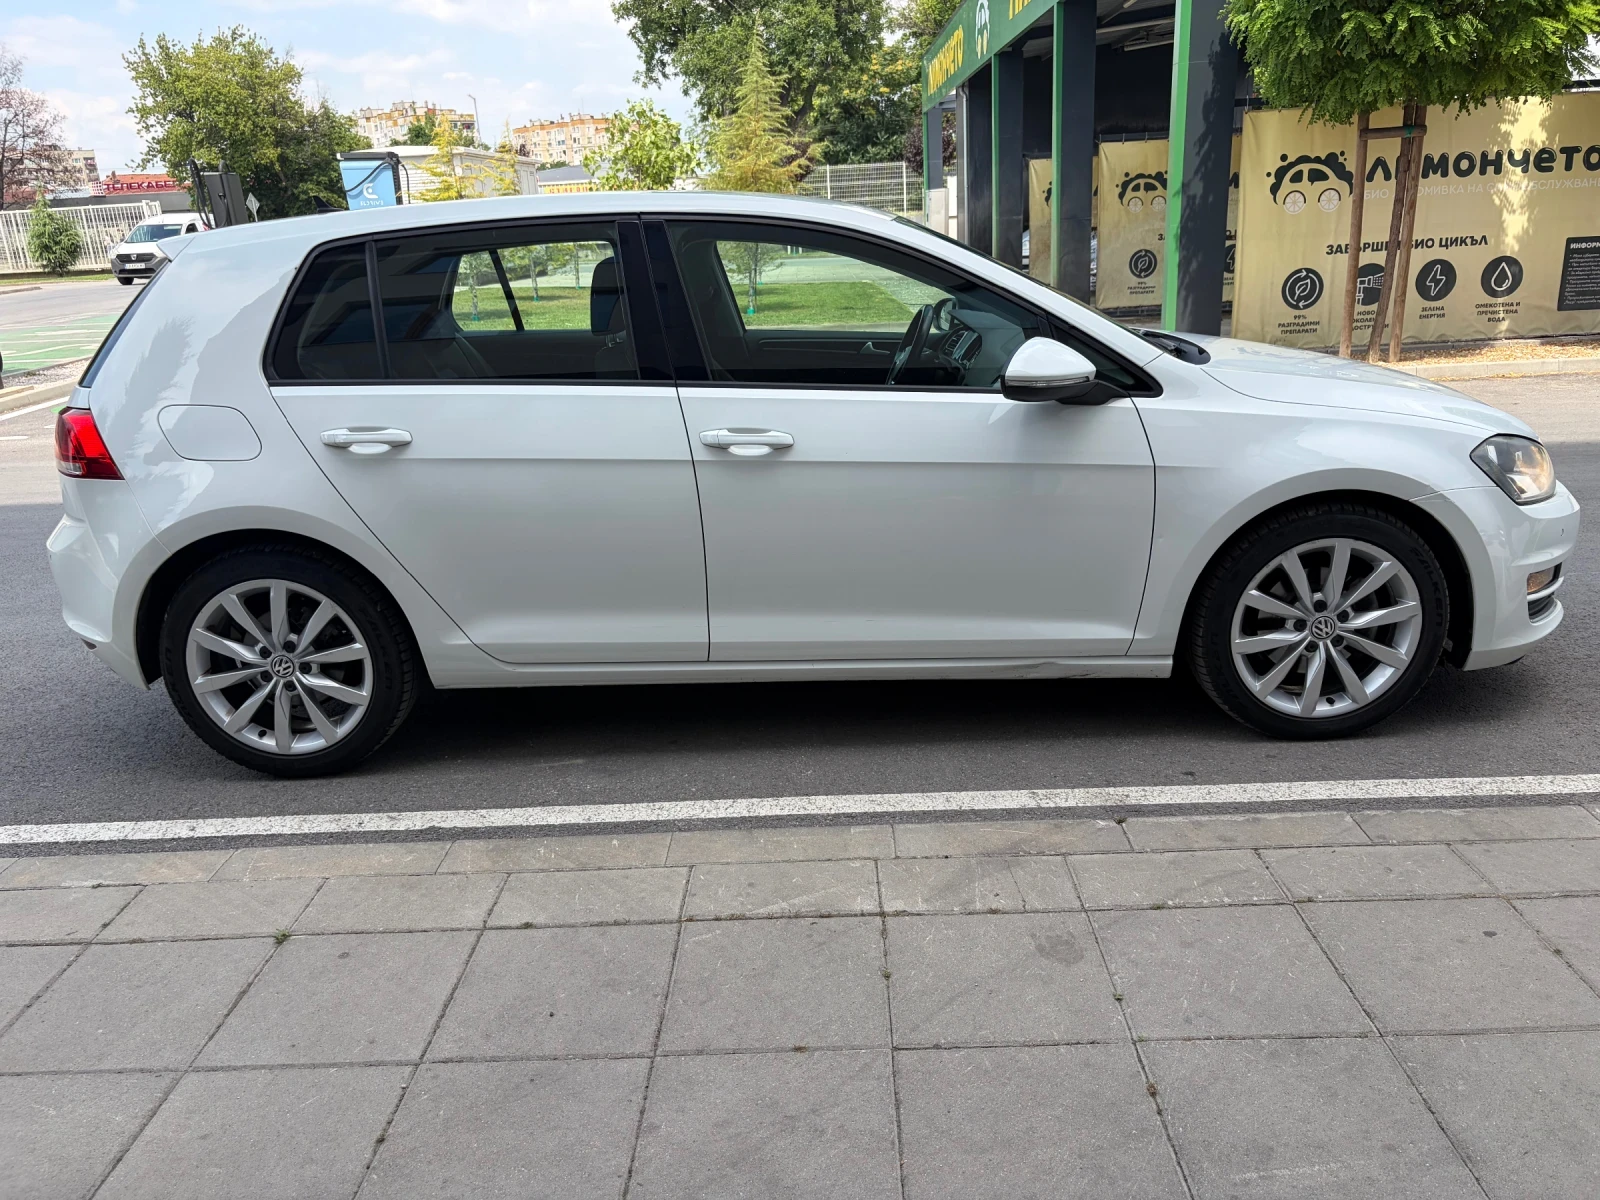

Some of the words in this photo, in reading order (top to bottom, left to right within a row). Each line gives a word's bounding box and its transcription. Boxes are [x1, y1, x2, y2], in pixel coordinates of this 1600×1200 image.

[1467, 183, 1485, 194] НА
[1438, 235, 1489, 250] ЦИКЪЛ
[1418, 312, 1446, 320] ЕНЕРГИЯ
